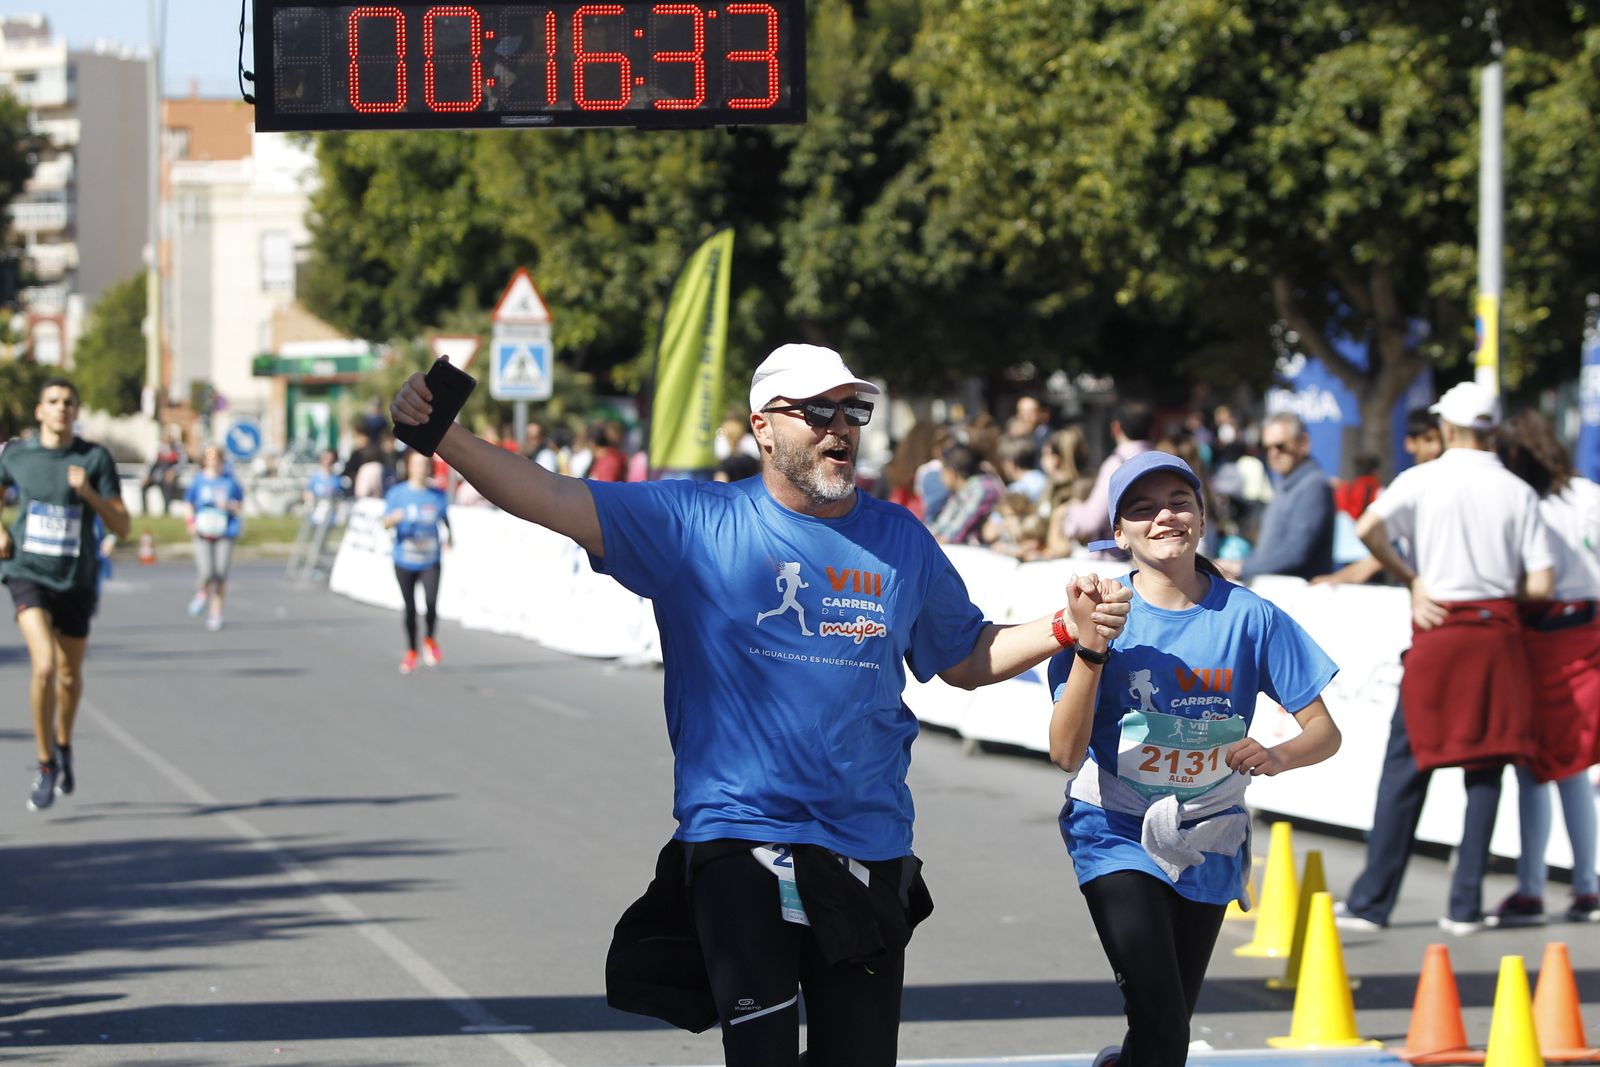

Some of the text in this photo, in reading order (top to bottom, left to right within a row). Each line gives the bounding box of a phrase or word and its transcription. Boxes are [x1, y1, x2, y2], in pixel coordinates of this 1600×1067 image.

[825, 566, 882, 597] VIII
[821, 597, 885, 613] CARRERA
[821, 608, 886, 621] DE LA
[749, 647, 880, 670] LA IGUALDAD ES NUESTRA META
[1174, 667, 1233, 693] VIII
[1169, 706, 1191, 715] DE
[1210, 705, 1230, 713] LA
[1170, 696, 1232, 708] CARRERA
[1138, 745, 1220, 776] 2131
[1168, 774, 1194, 784] ALBA
